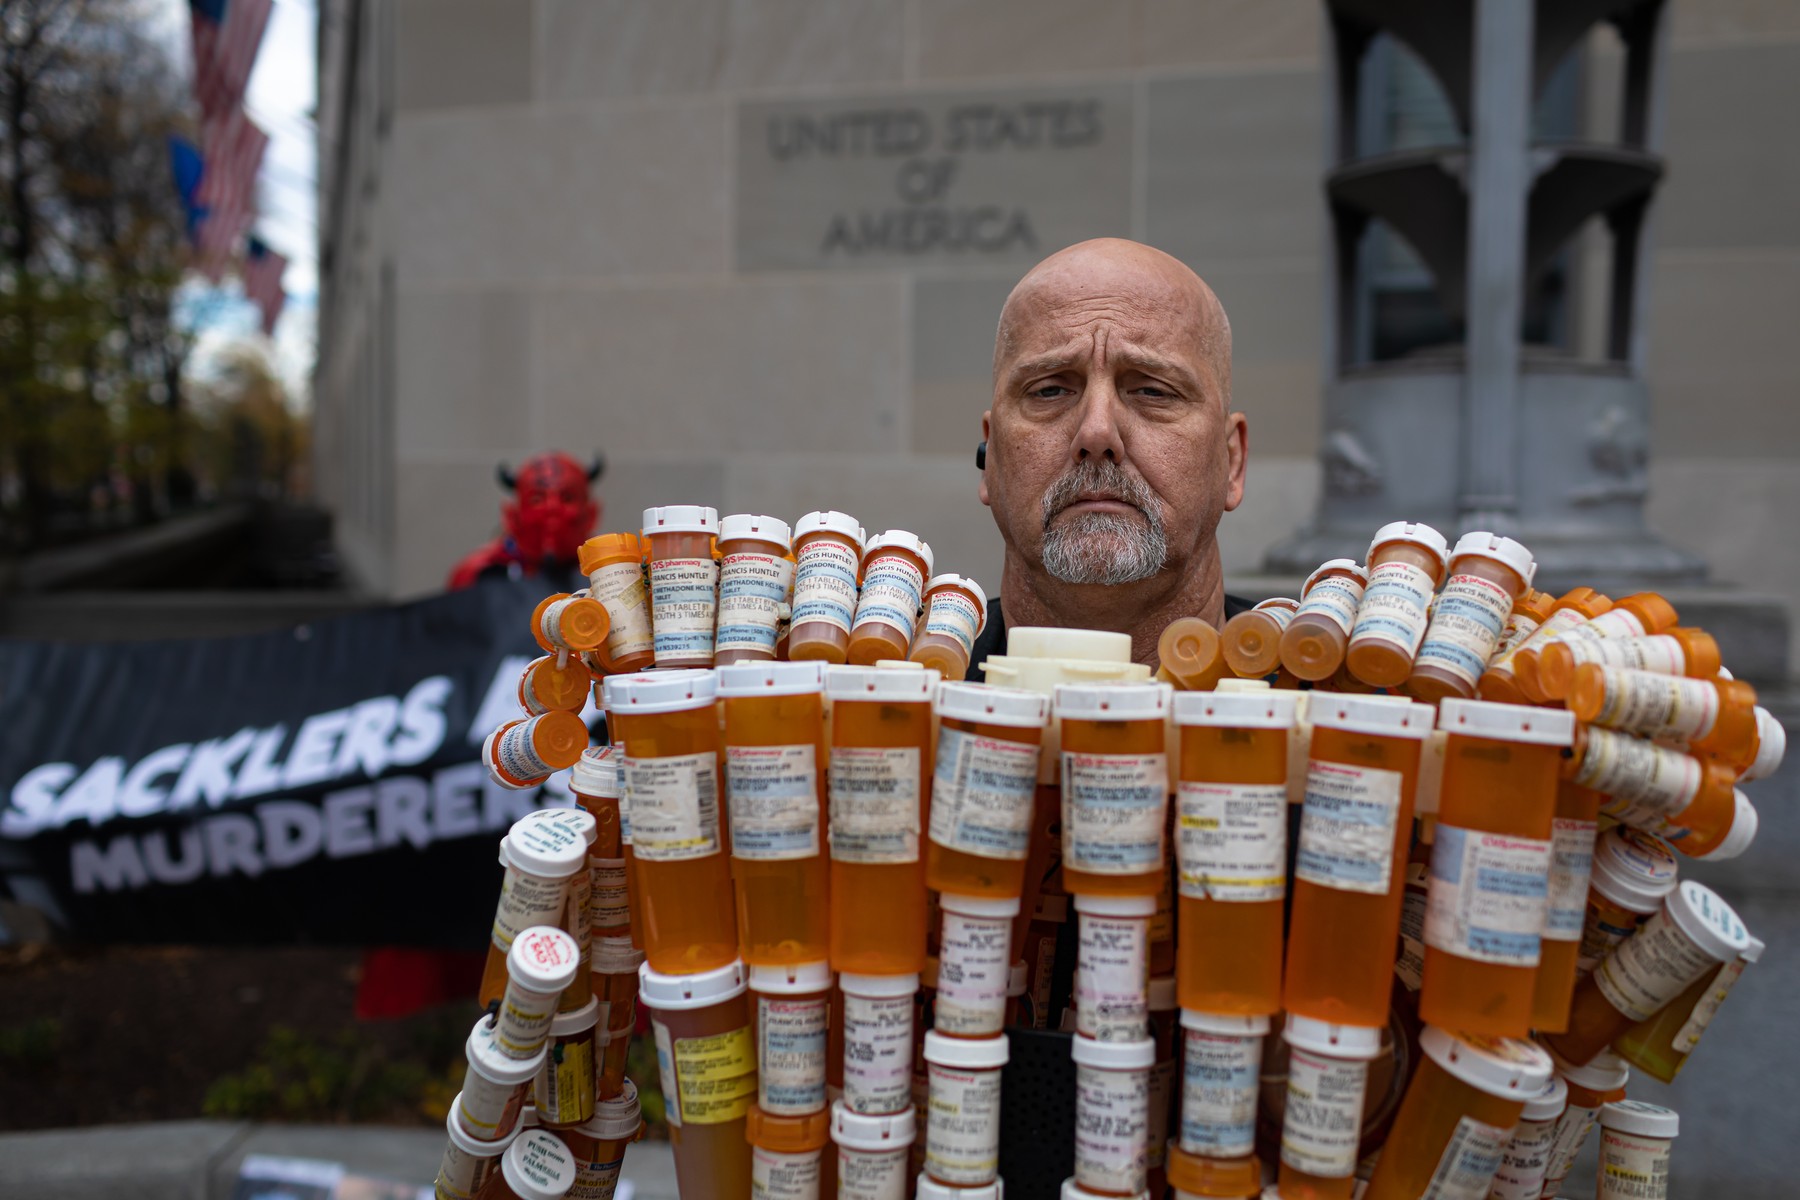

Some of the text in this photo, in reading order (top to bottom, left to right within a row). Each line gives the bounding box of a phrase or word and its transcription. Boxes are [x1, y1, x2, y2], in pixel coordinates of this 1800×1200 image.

[767, 101, 1102, 159] UNITED STATES
[897, 157, 958, 202] OF
[821, 206, 1038, 254] AMERICA
[750, 567, 780, 578] HUNTLEY
[822, 552, 852, 566] HUNTLEY
[814, 577, 840, 587] TABLET
[824, 584, 844, 594] TIMES
[1, 676, 456, 839] SACKLERS
